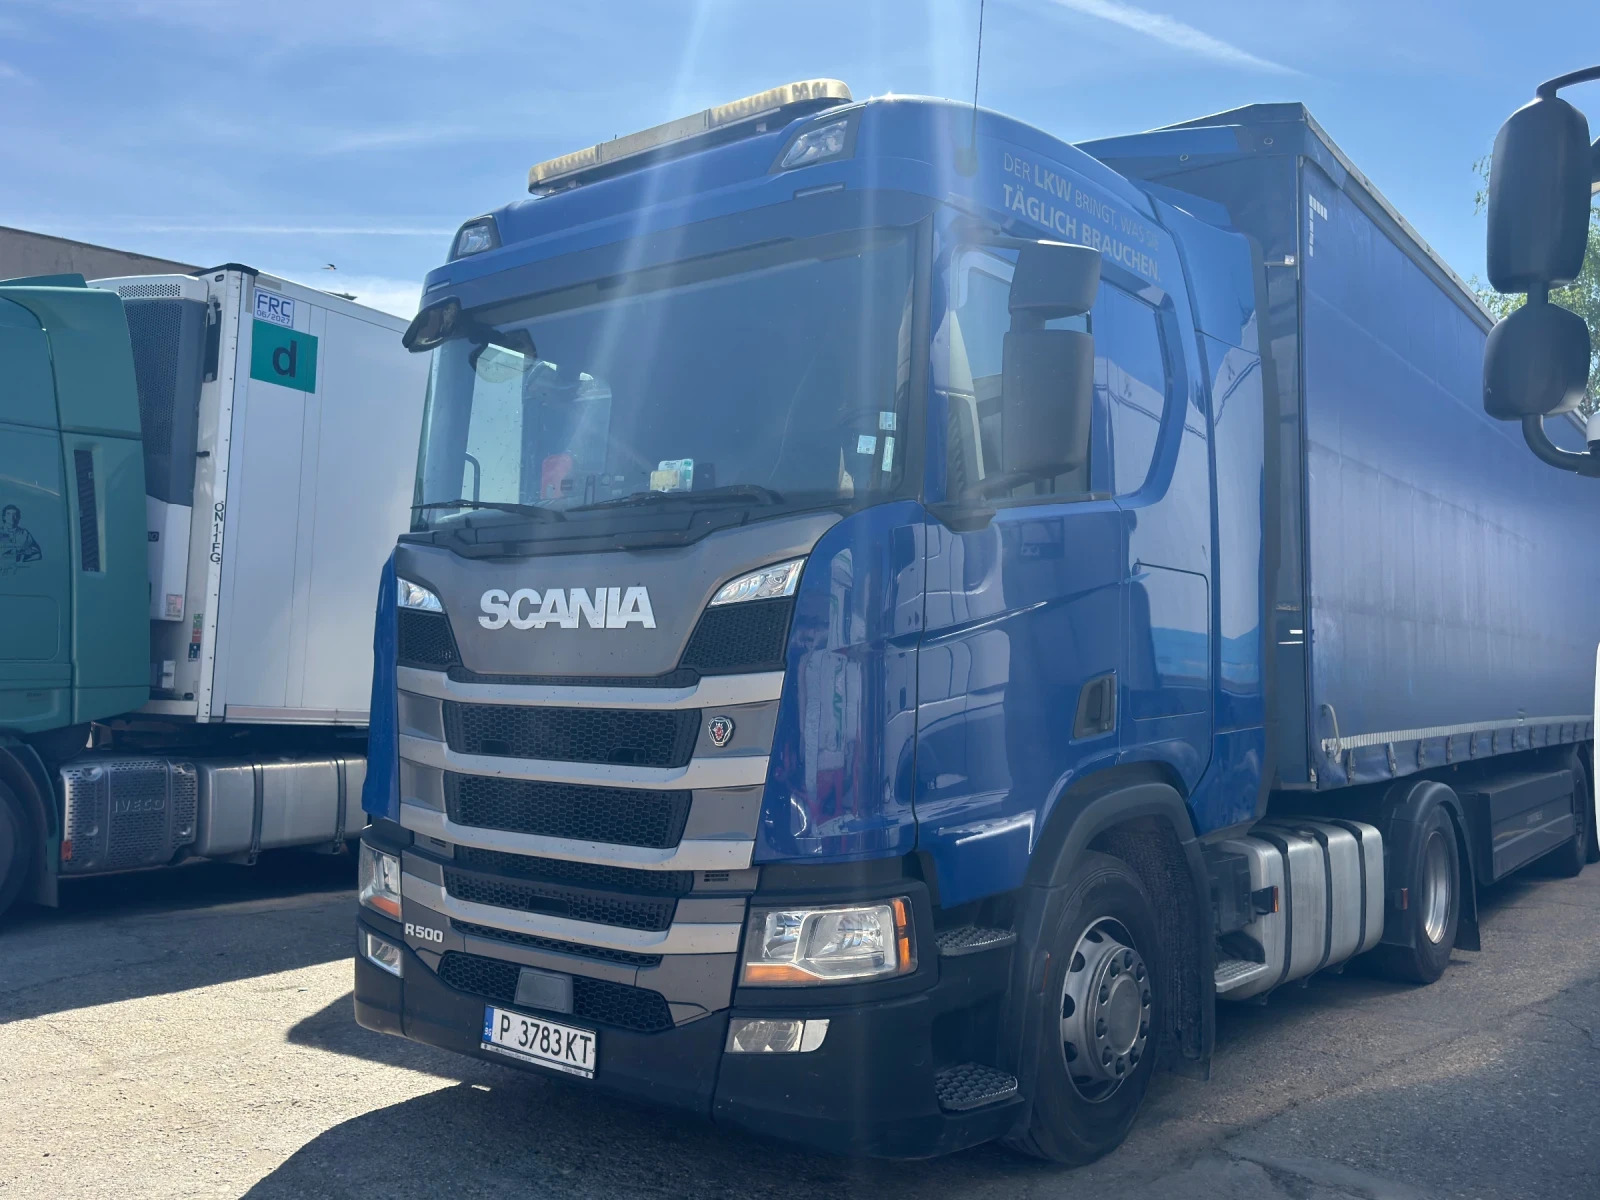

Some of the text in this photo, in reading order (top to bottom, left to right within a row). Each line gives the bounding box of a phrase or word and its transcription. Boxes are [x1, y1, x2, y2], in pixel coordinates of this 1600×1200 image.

[1004, 152, 1031, 182] DER
[1034, 164, 1072, 202] LKW
[1075, 189, 1118, 231] BRINGT,
[1120, 215, 1144, 243] WAS
[1003, 183, 1161, 282] TÄGLICH BRAUCHEN.
[256, 309, 291, 325] 06/2027
[257, 294, 291, 318] FRC
[272, 339, 297, 378] d
[477, 586, 657, 630] SCANIA
[113, 799, 165, 813] IVECO
[405, 922, 444, 943] R500
